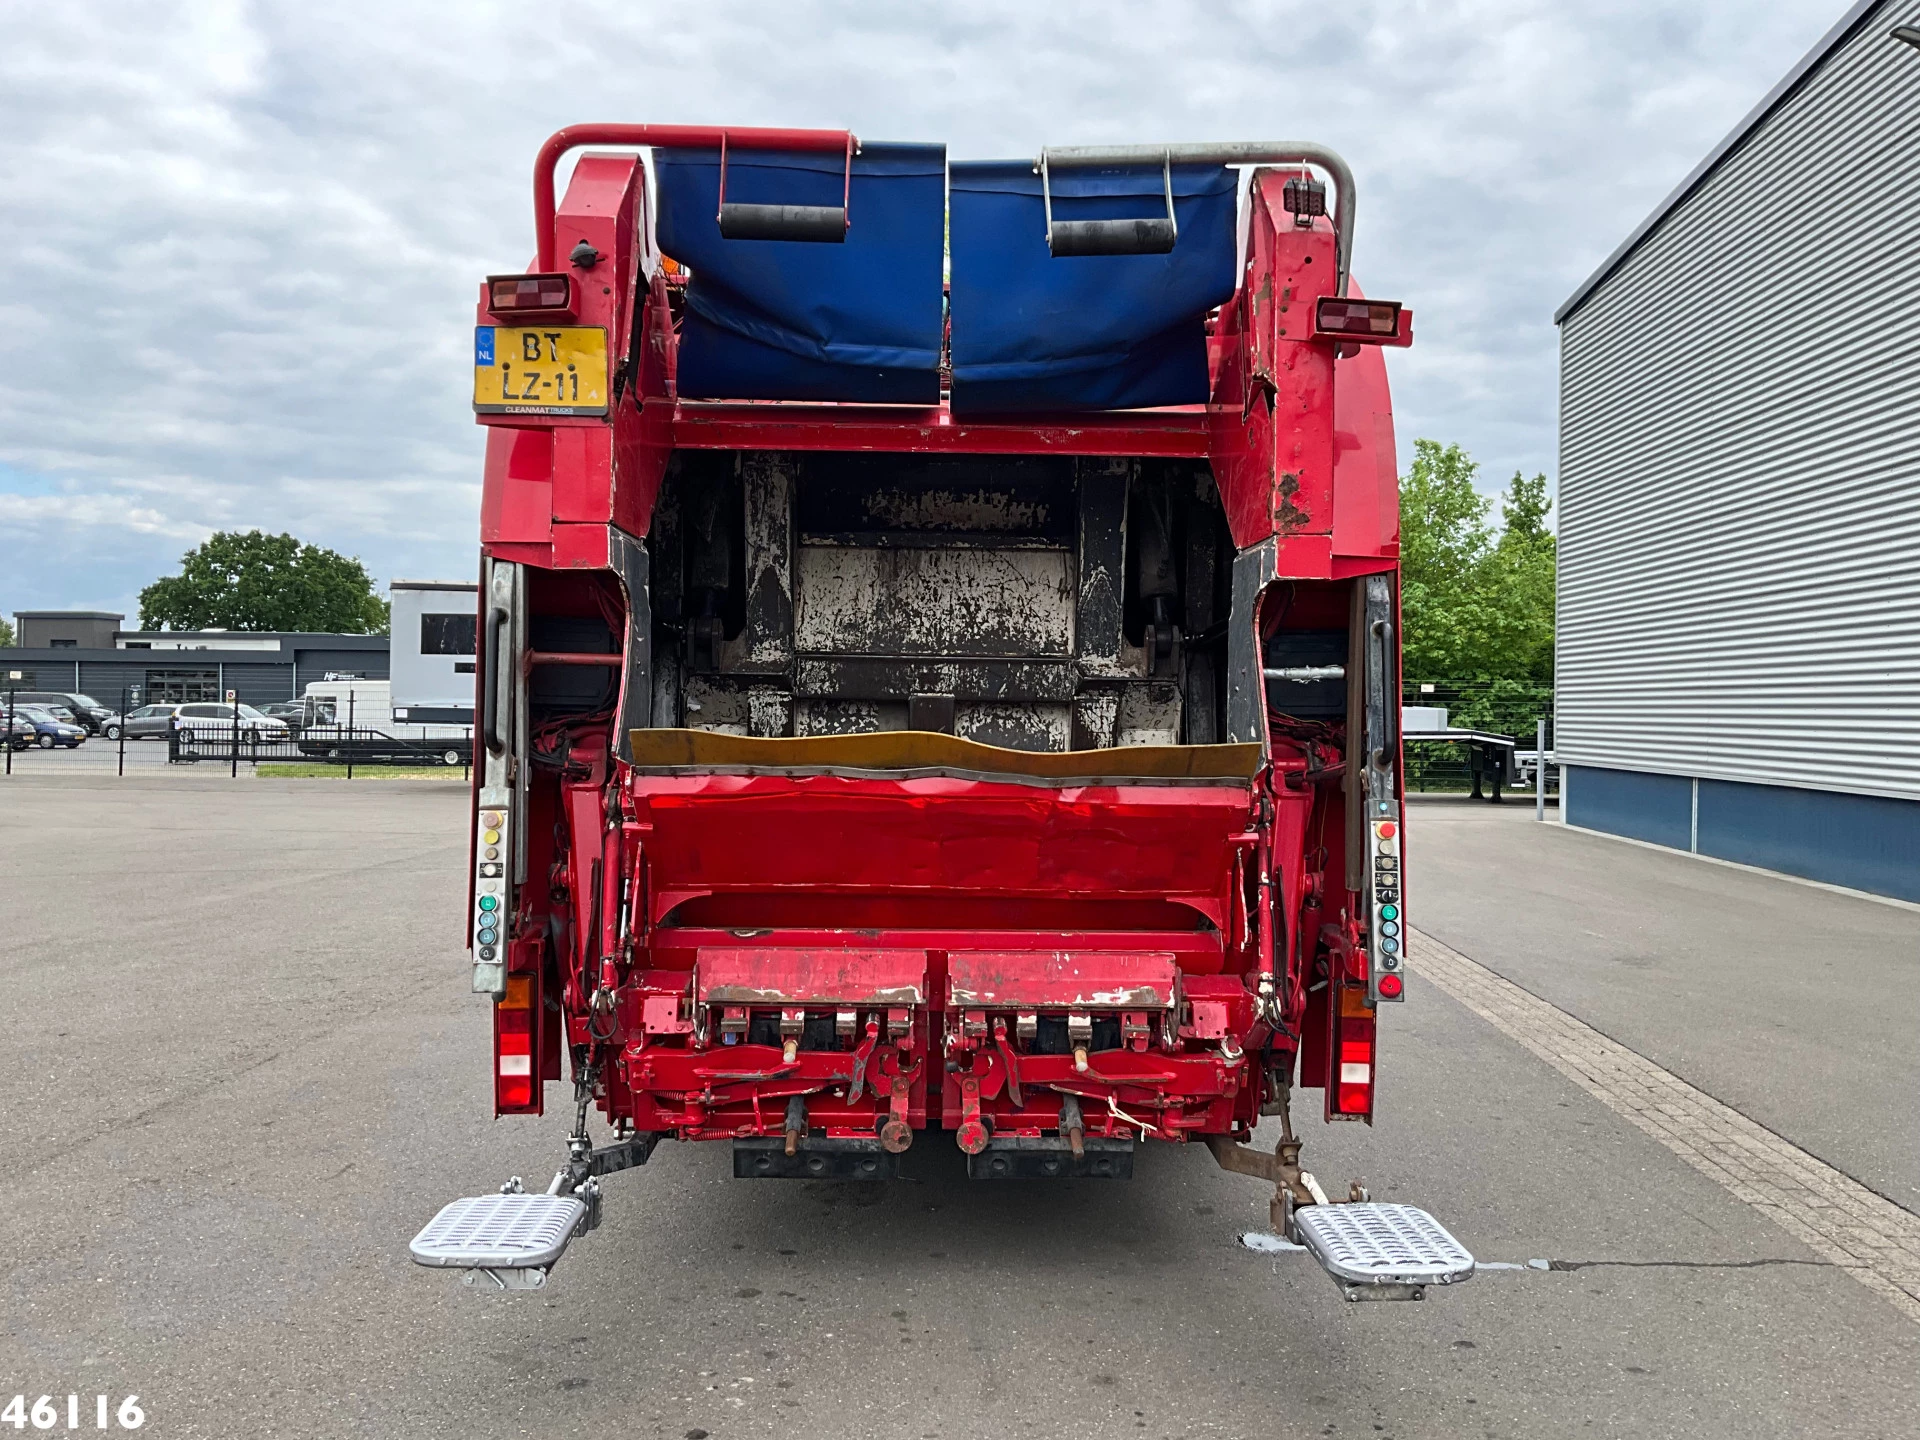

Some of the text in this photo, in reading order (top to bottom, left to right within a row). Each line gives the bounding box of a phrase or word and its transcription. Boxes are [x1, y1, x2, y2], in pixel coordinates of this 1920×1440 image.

[478, 350, 492, 360] NL
[522, 333, 561, 361] BT
[502, 372, 578, 400] LZ-11
